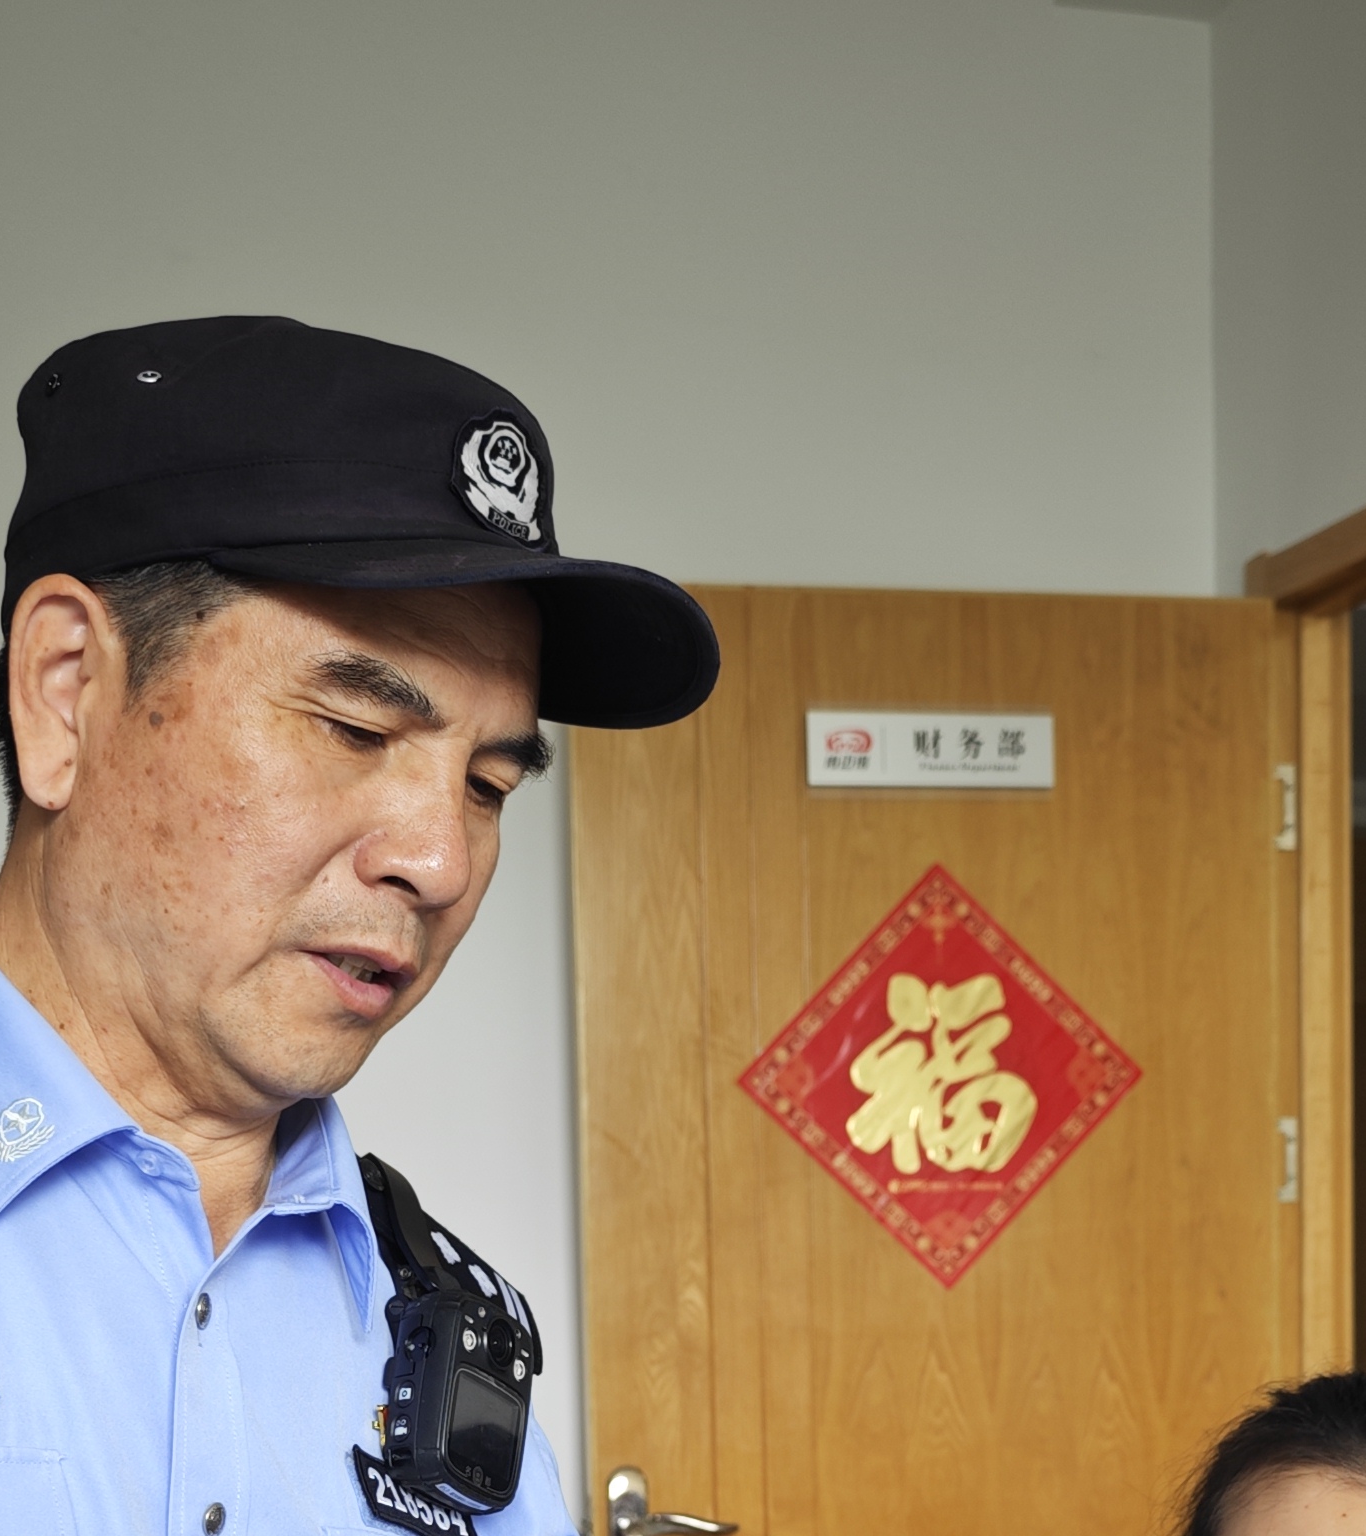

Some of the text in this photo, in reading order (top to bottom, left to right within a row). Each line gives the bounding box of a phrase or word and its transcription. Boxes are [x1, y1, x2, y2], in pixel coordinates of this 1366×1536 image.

[492, 511, 527, 539] POLICE
[913, 728, 1027, 759] 财务部
[845, 972, 1038, 1174] 福
